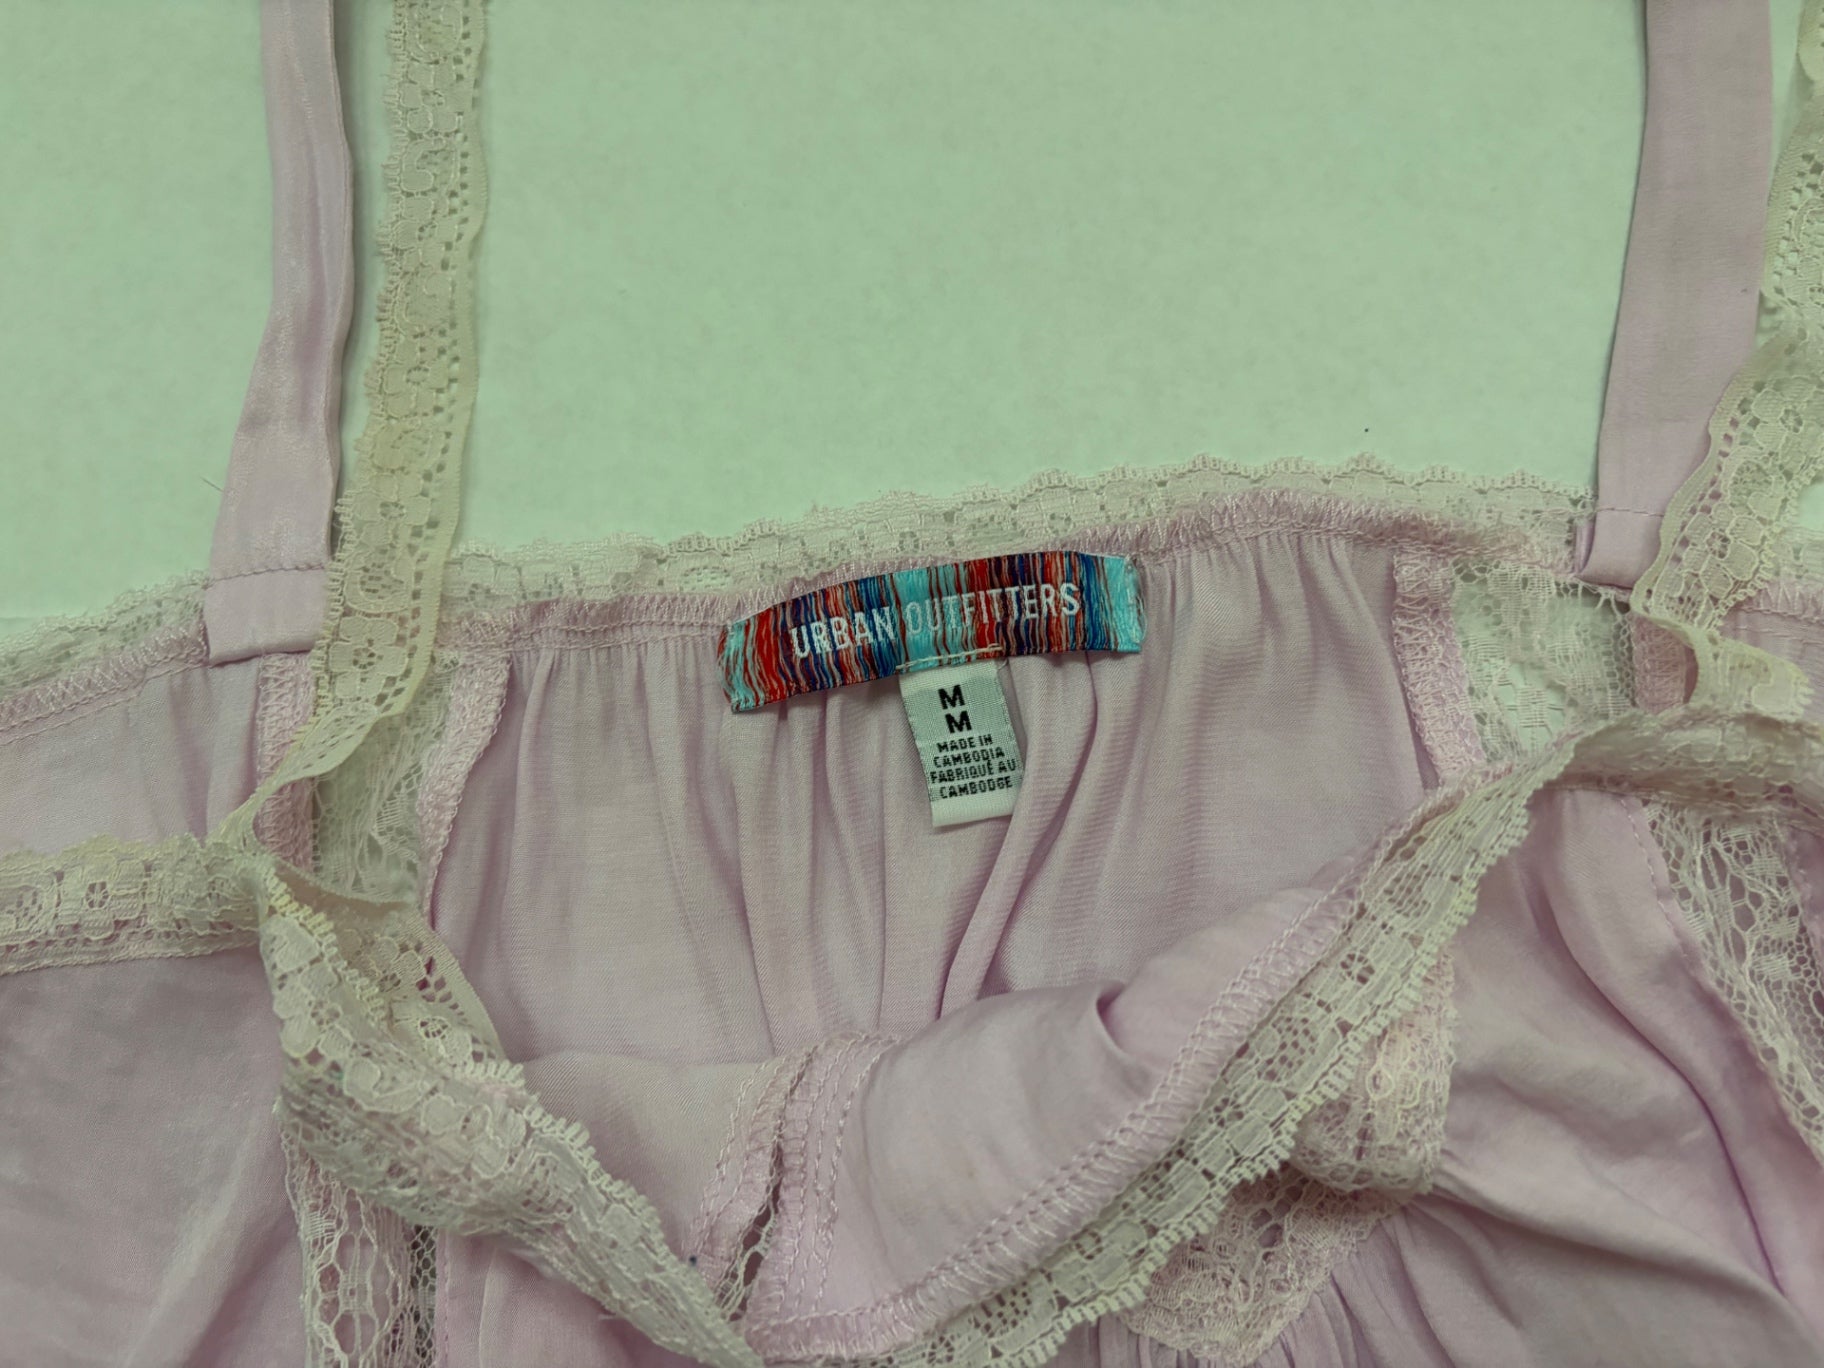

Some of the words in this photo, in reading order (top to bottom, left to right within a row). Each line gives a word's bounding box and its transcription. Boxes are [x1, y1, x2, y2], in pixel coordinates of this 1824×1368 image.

[792, 606, 898, 658] URBAN
[906, 583, 1080, 635] OUTFITTERS
[938, 684, 966, 710] M
[945, 710, 972, 733] M
[936, 737, 977, 753] MADE
[979, 734, 993, 747] IN
[933, 747, 1005, 768] CAMBODIA
[998, 759, 1016, 773] AU
[939, 776, 1013, 799] CAMBODGE
